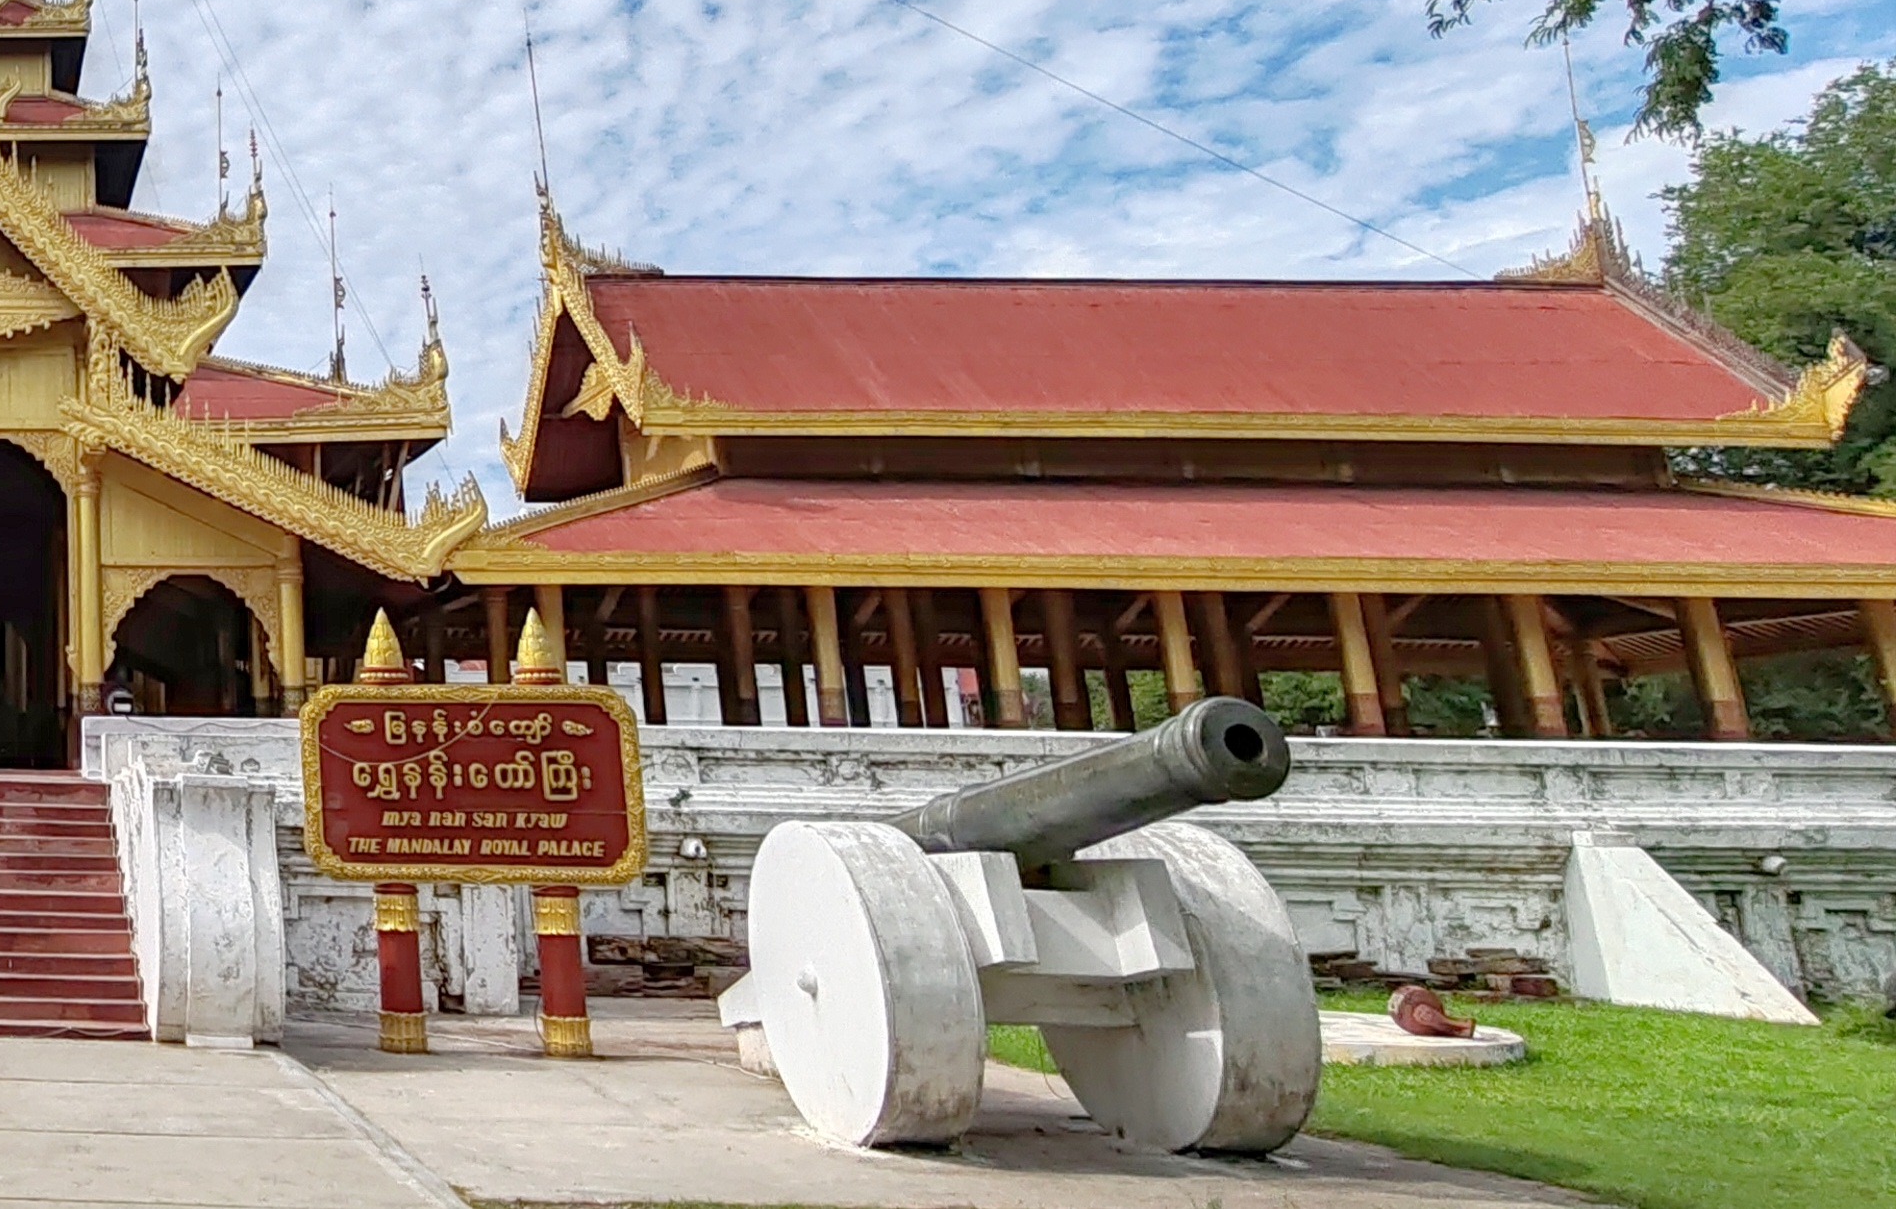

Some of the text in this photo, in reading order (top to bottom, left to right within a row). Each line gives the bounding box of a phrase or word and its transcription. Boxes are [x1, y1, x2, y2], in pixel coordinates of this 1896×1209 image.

[381, 811, 422, 827] mya
[428, 811, 466, 827] nan
[348, 837, 605, 857] THE MANDALAY ROYAL PALACE
